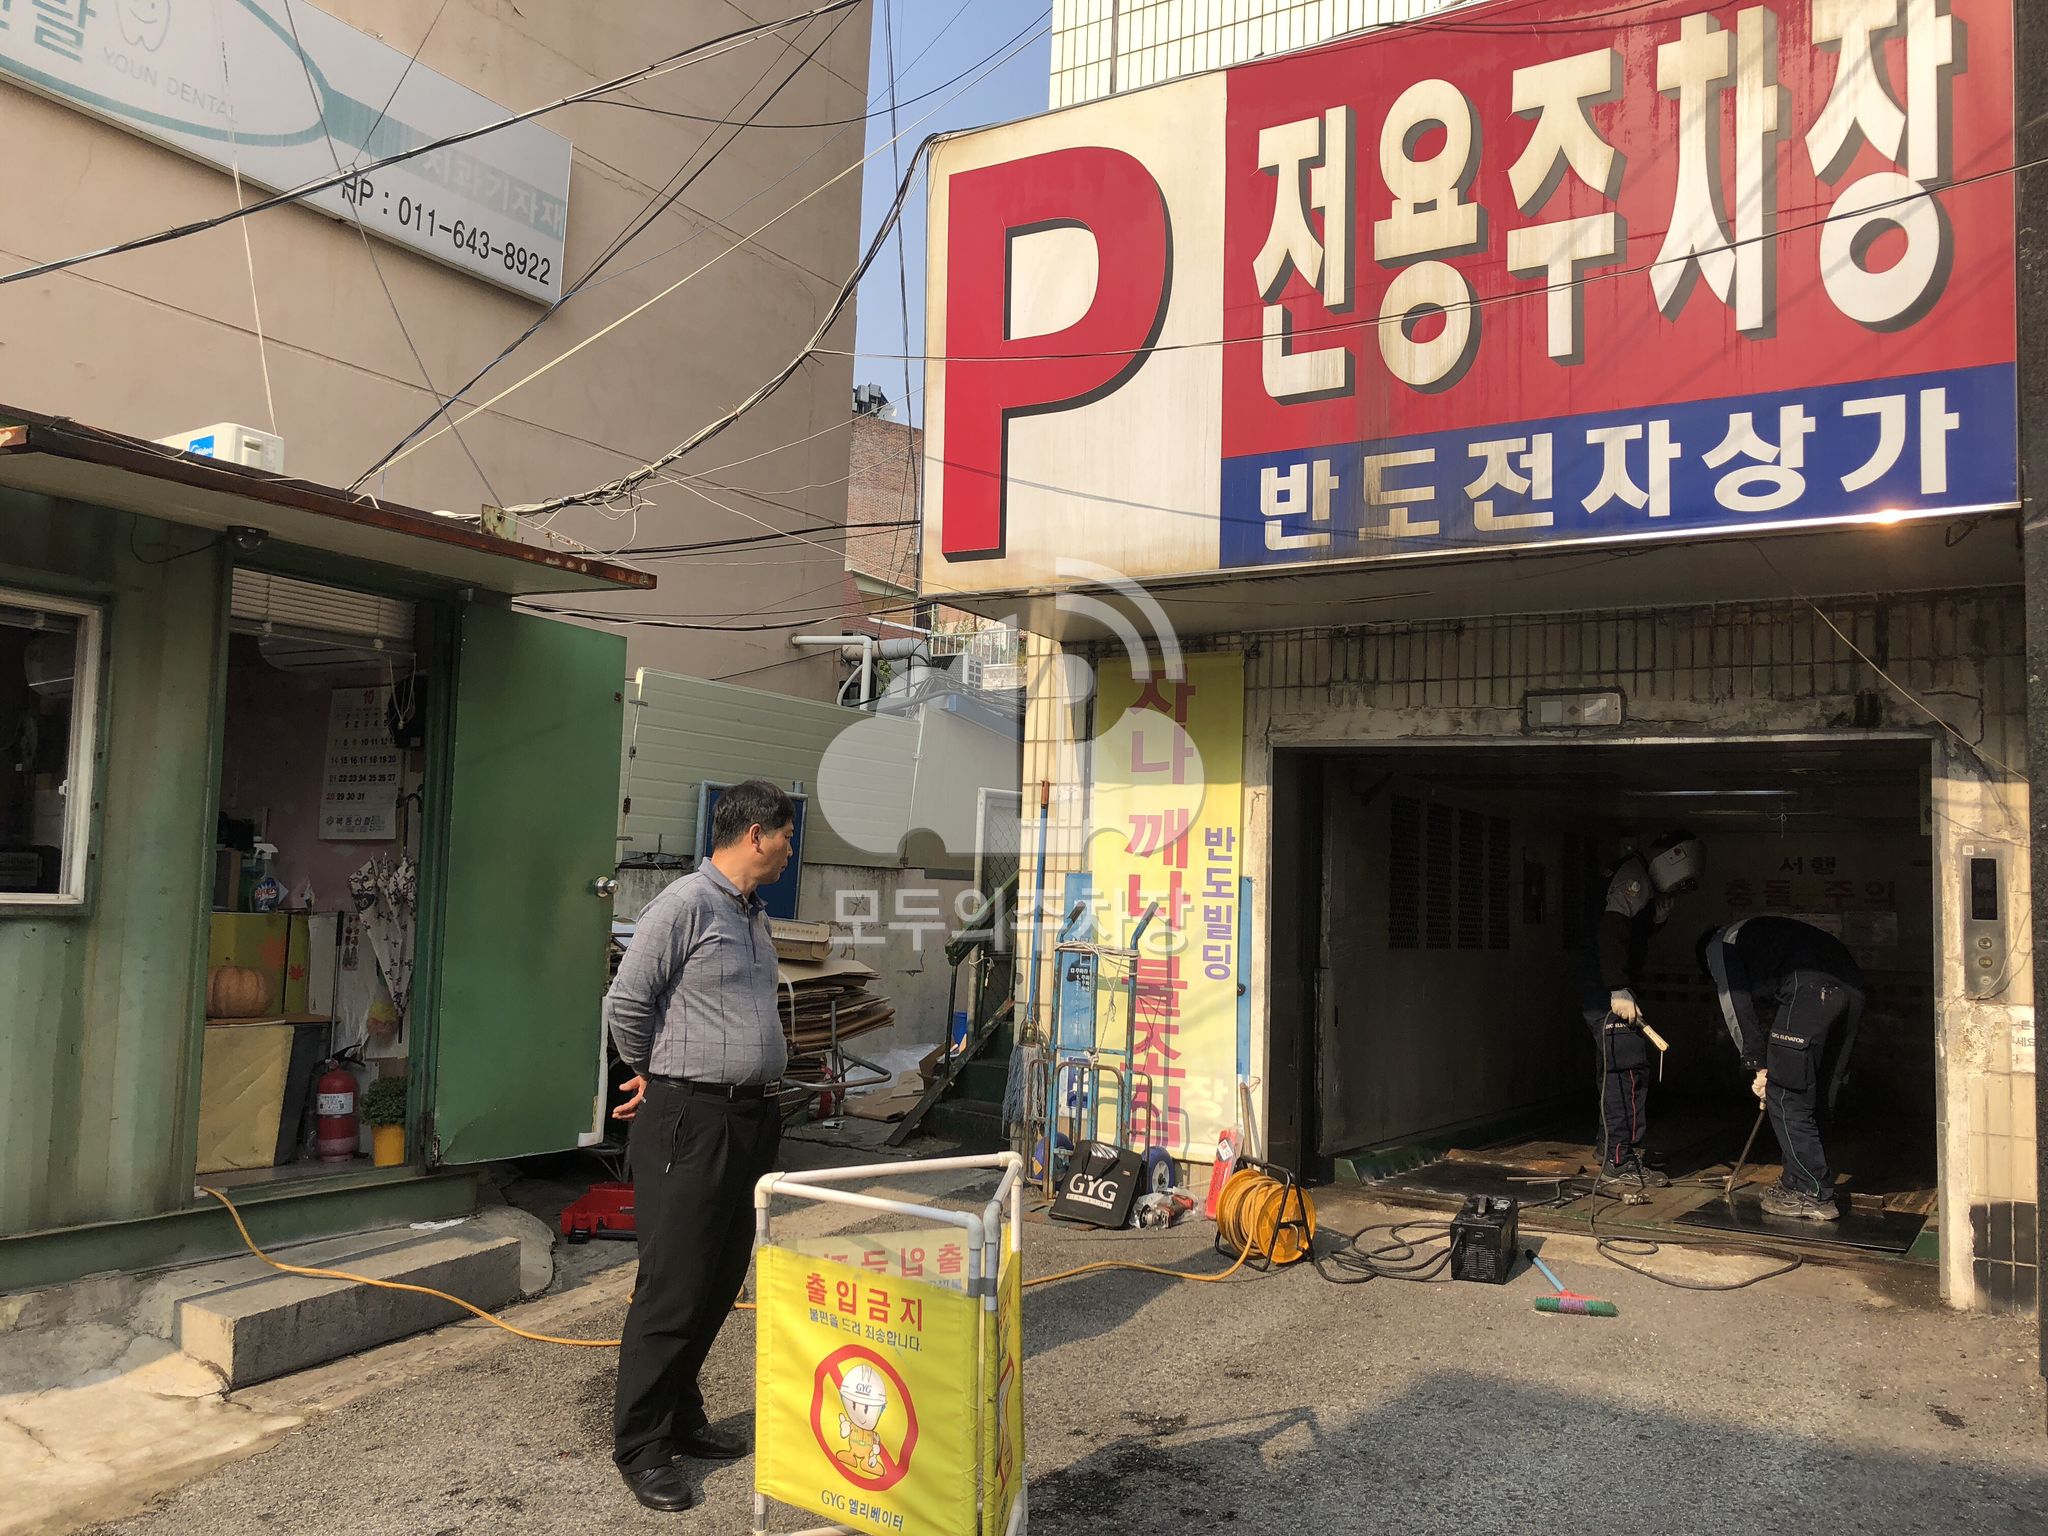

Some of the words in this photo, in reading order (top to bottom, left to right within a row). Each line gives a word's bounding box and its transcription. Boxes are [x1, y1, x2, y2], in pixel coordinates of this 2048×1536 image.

[103, 47, 158, 88] YOUN
[167, 77, 239, 125] DENTAL
[342, 171, 375, 206] HP
[398, 196, 552, 286] 011-643-8922
[1253, 0, 1968, 405] 전용주차장
[942, 146, 1174, 563] P
[1260, 386, 1961, 551] 반도전자상가
[363, 689, 374, 704] 10
[1202, 826, 1236, 981] 반도빌딩
[1069, 1173, 1119, 1202] GYG
[805, 1272, 923, 1332] 출입금지
[809, 1307, 839, 1329] 불편을
[865, 1325, 923, 1351] 죄송합니다.
[855, 1382, 872, 1394] GYG
[821, 1489, 846, 1509] GYG
[848, 1498, 904, 1532] 엘리베이터
